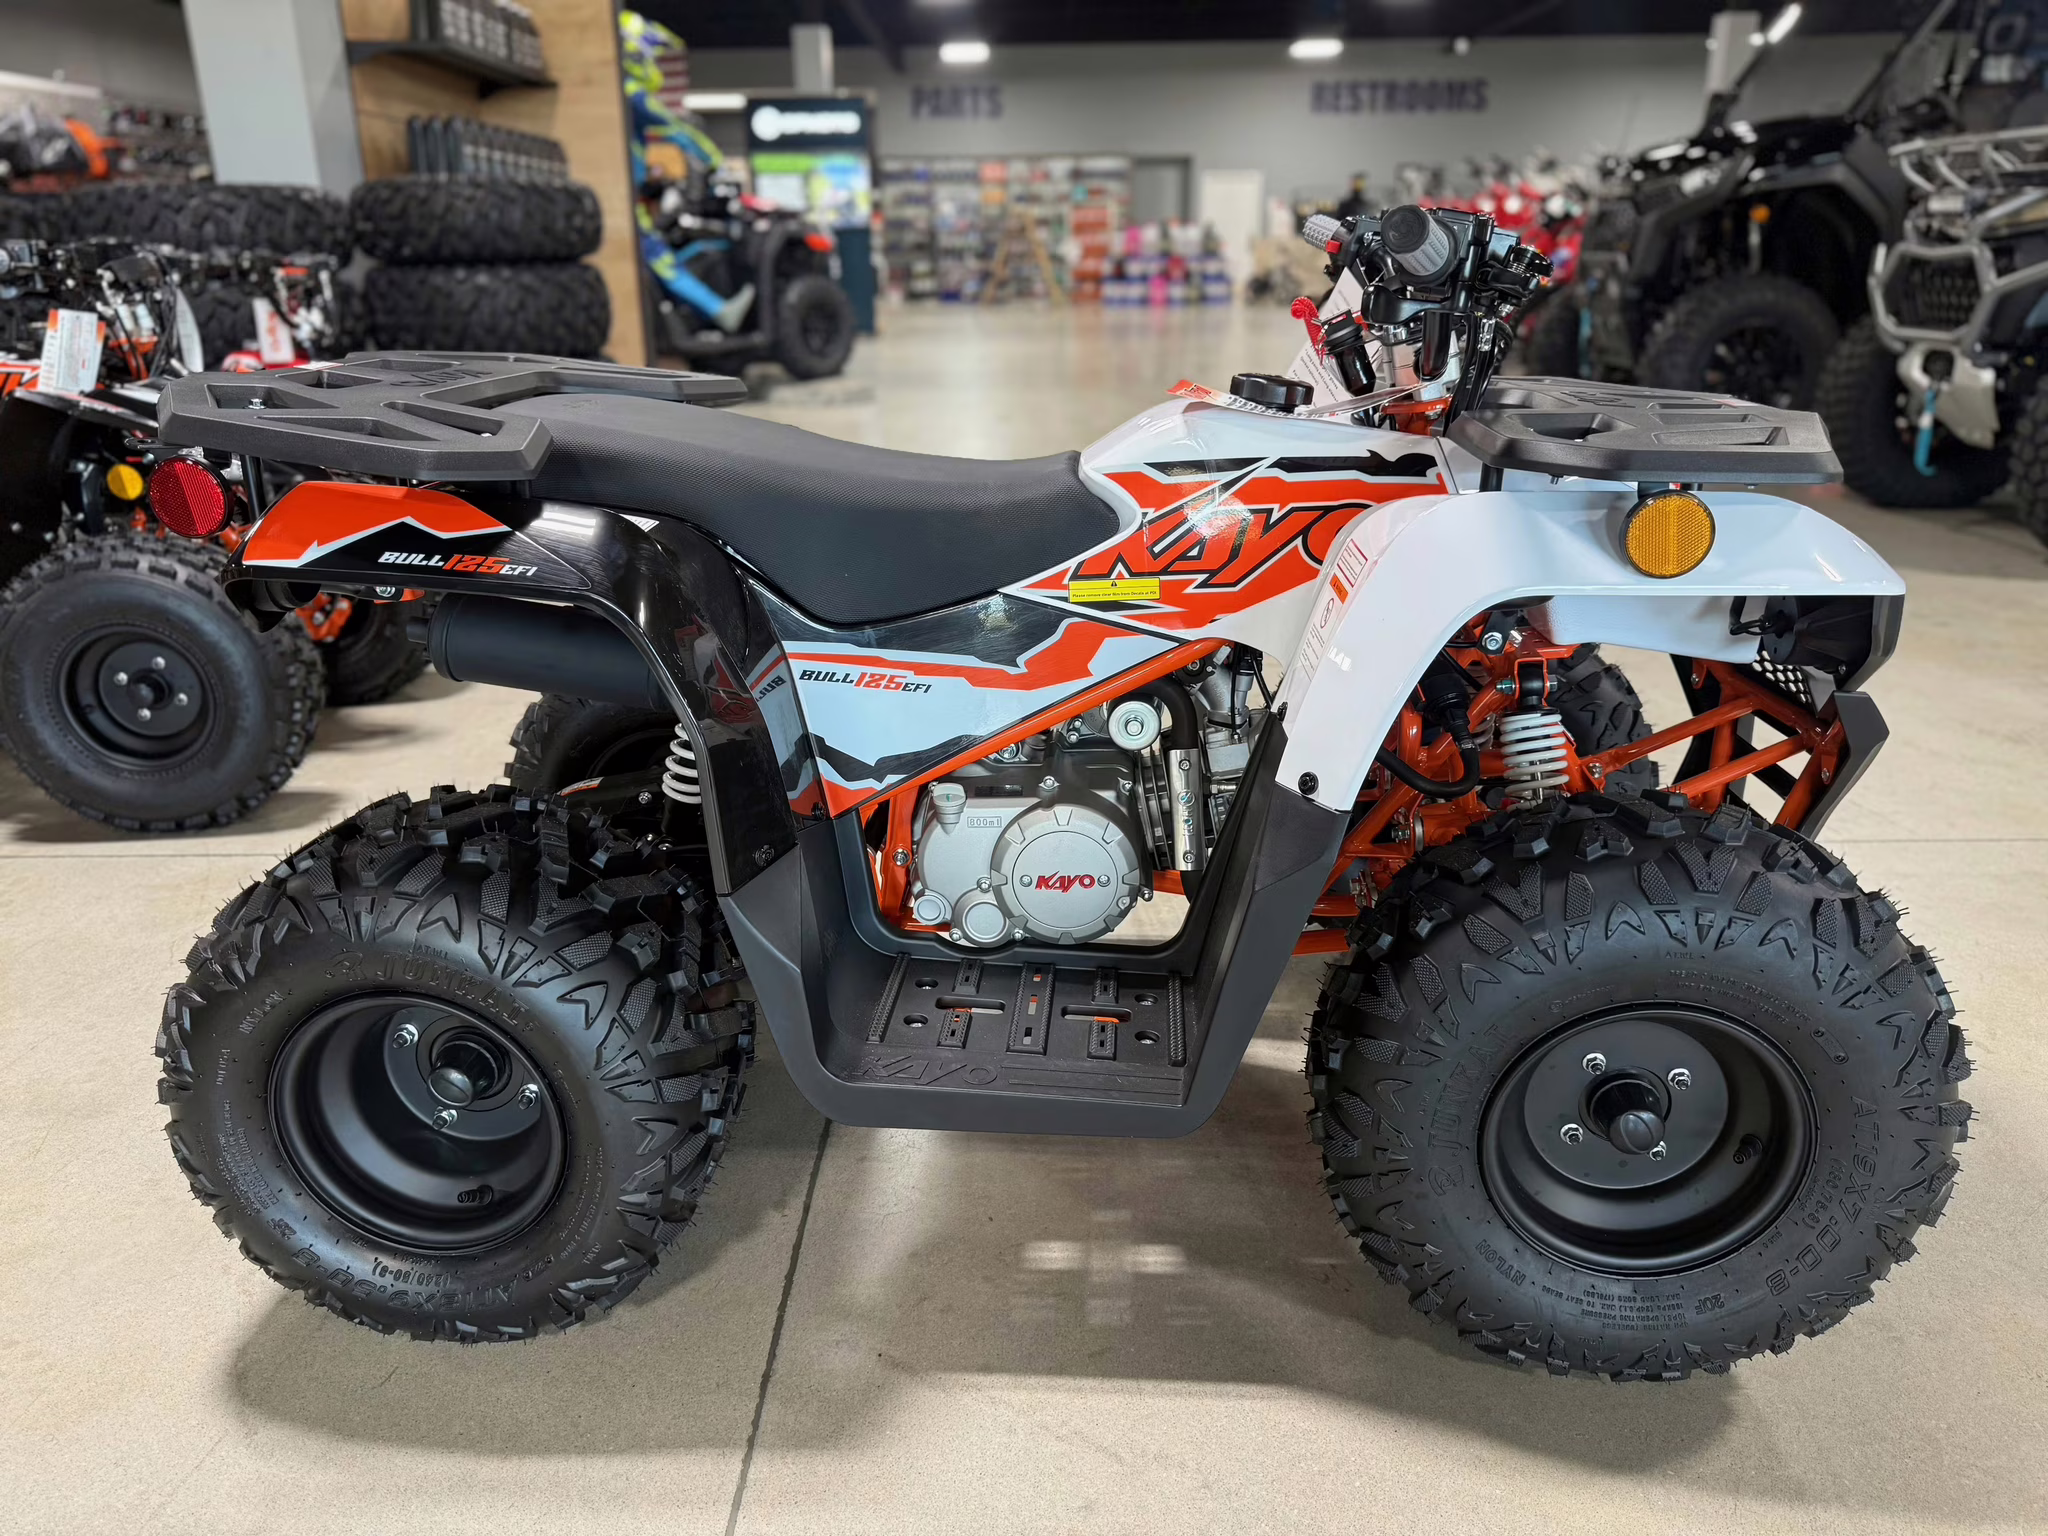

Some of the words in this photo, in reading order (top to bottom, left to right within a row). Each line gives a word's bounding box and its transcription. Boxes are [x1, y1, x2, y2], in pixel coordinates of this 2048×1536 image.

[911, 85, 1004, 118] PARTS
[1311, 79, 1488, 113] RESTROOMS
[969, 818, 1000, 826] 800ml
[1034, 869, 1096, 893] KAYO
[858, 1055, 998, 1086] KAYO
[1765, 1095, 1877, 1295] AT19X7.00-8
[1469, 1238, 1529, 1286] NYLON
[1692, 1293, 1726, 1315] 20F
